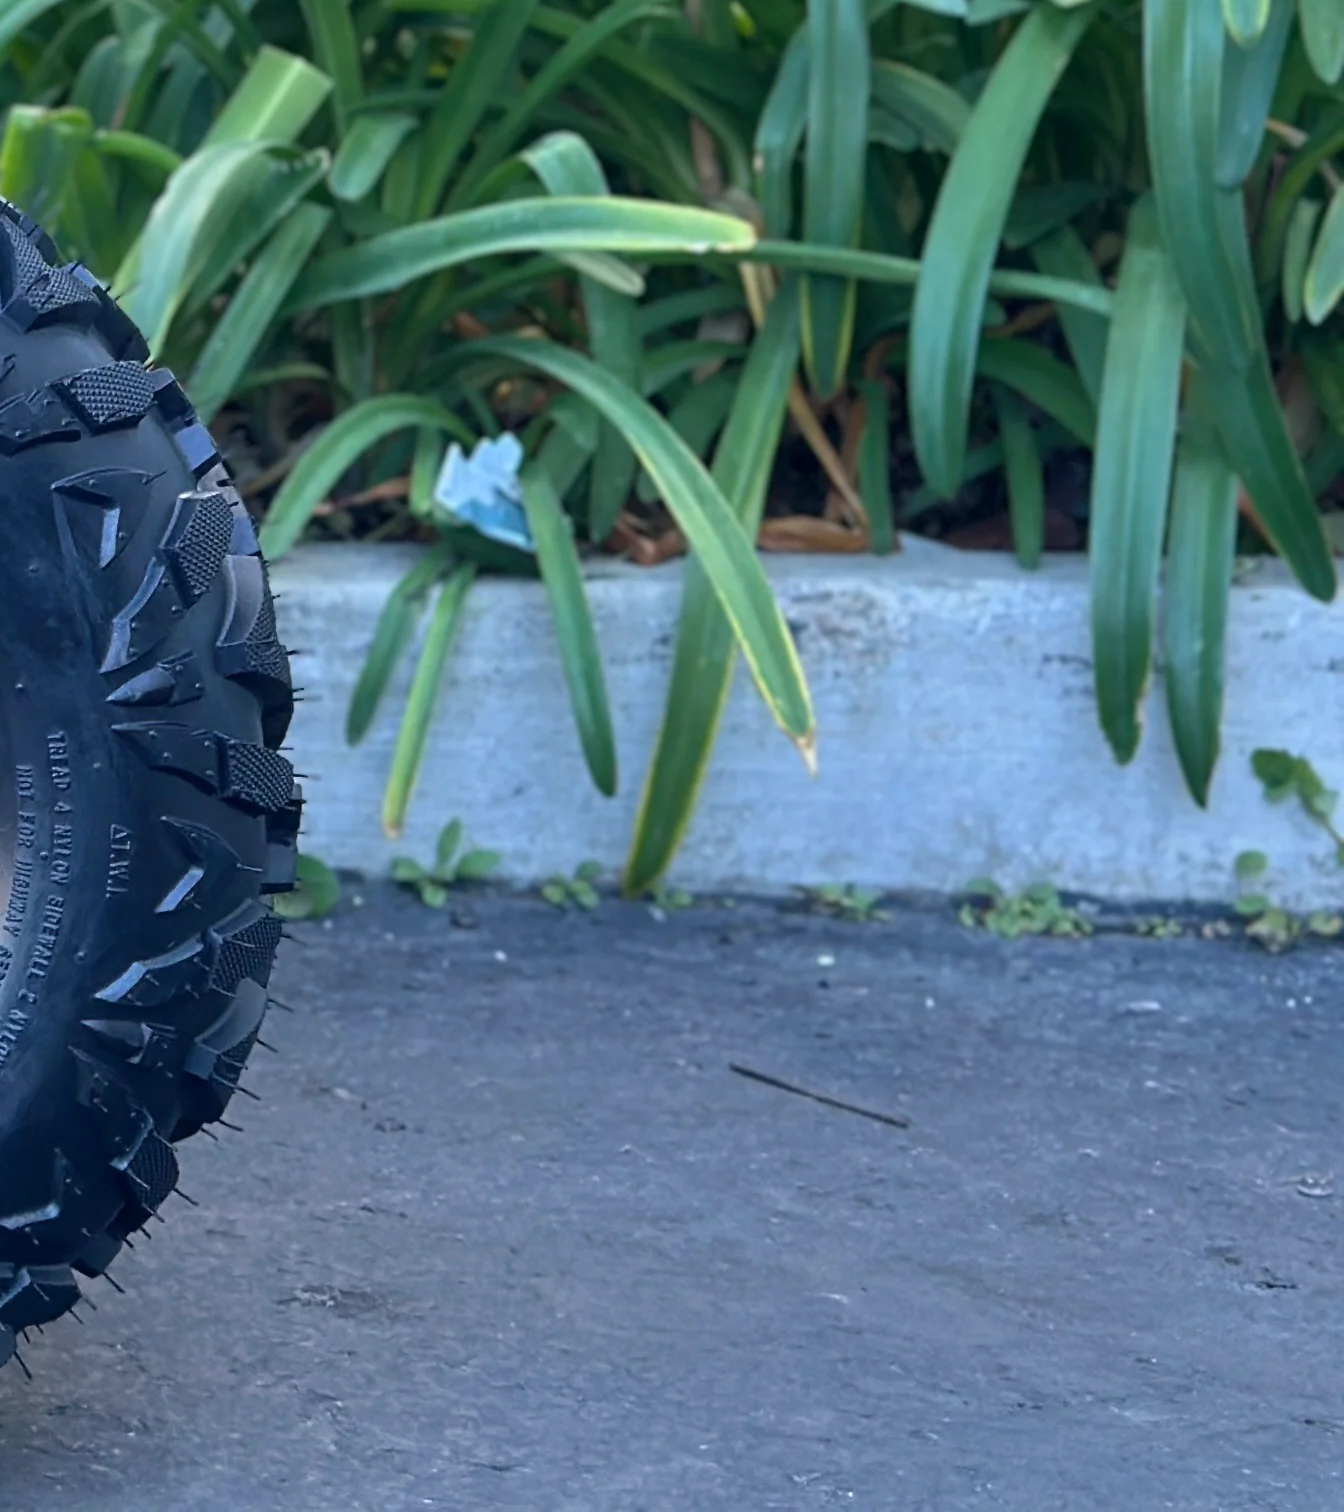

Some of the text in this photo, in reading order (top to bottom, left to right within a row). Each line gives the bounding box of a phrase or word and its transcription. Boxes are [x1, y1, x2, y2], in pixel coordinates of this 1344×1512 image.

[14, 765, 35, 801] NOT
[46, 731, 72, 791] TREAD
[50, 825, 74, 885] NYLON
[2, 861, 33, 938] HIGHWAY
[28, 895, 65, 981] SIDEWALL
